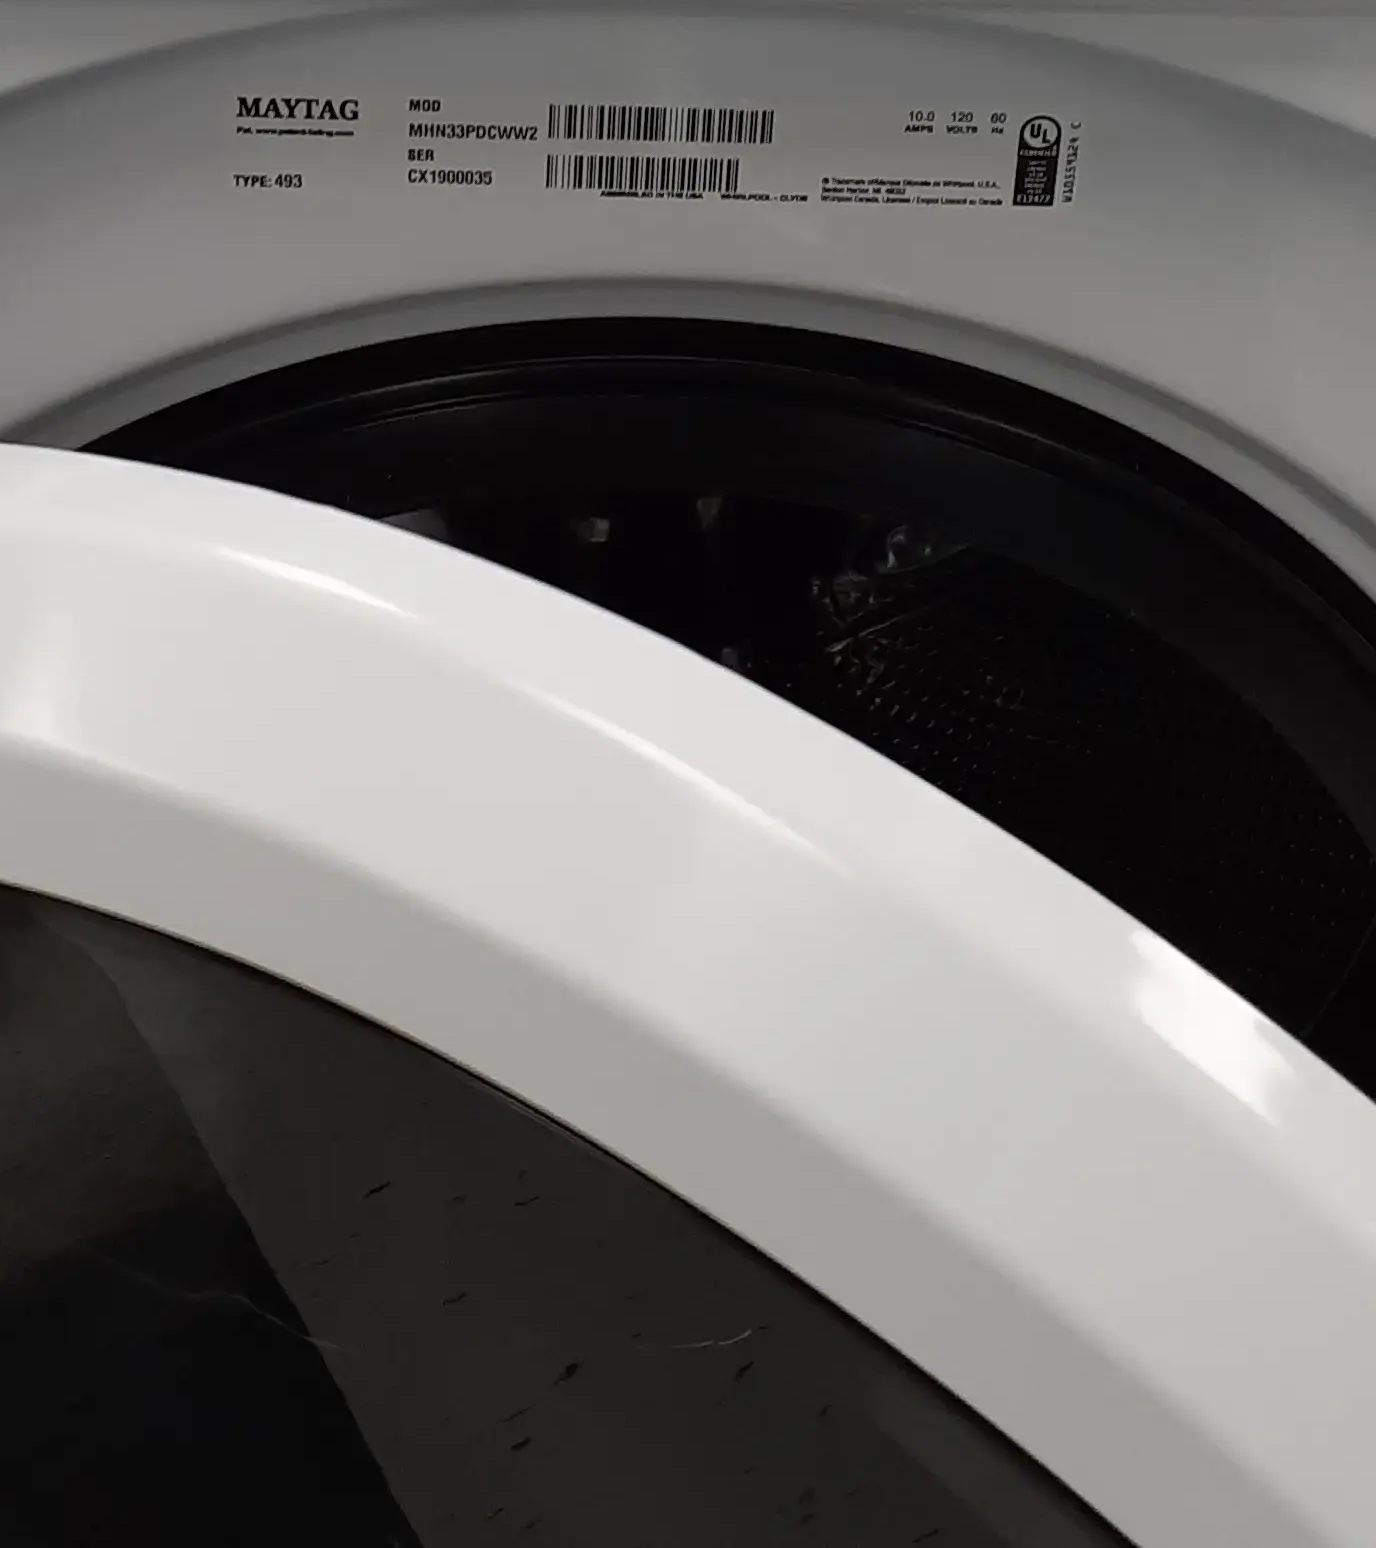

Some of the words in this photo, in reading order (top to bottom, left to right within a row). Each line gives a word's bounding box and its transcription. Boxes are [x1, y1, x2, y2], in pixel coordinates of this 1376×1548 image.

[236, 96, 360, 122] MAYTAG
[409, 98, 441, 113] MOD
[909, 110, 935, 122] 10.0
[951, 111, 974, 123] 120
[409, 123, 539, 143] MHN33PDCWW2
[1029, 123, 1051, 144] UL
[408, 148, 435, 162] SER
[234, 174, 273, 189] TYPE:
[275, 173, 303, 189] 493
[407, 168, 493, 186] CX1900035
